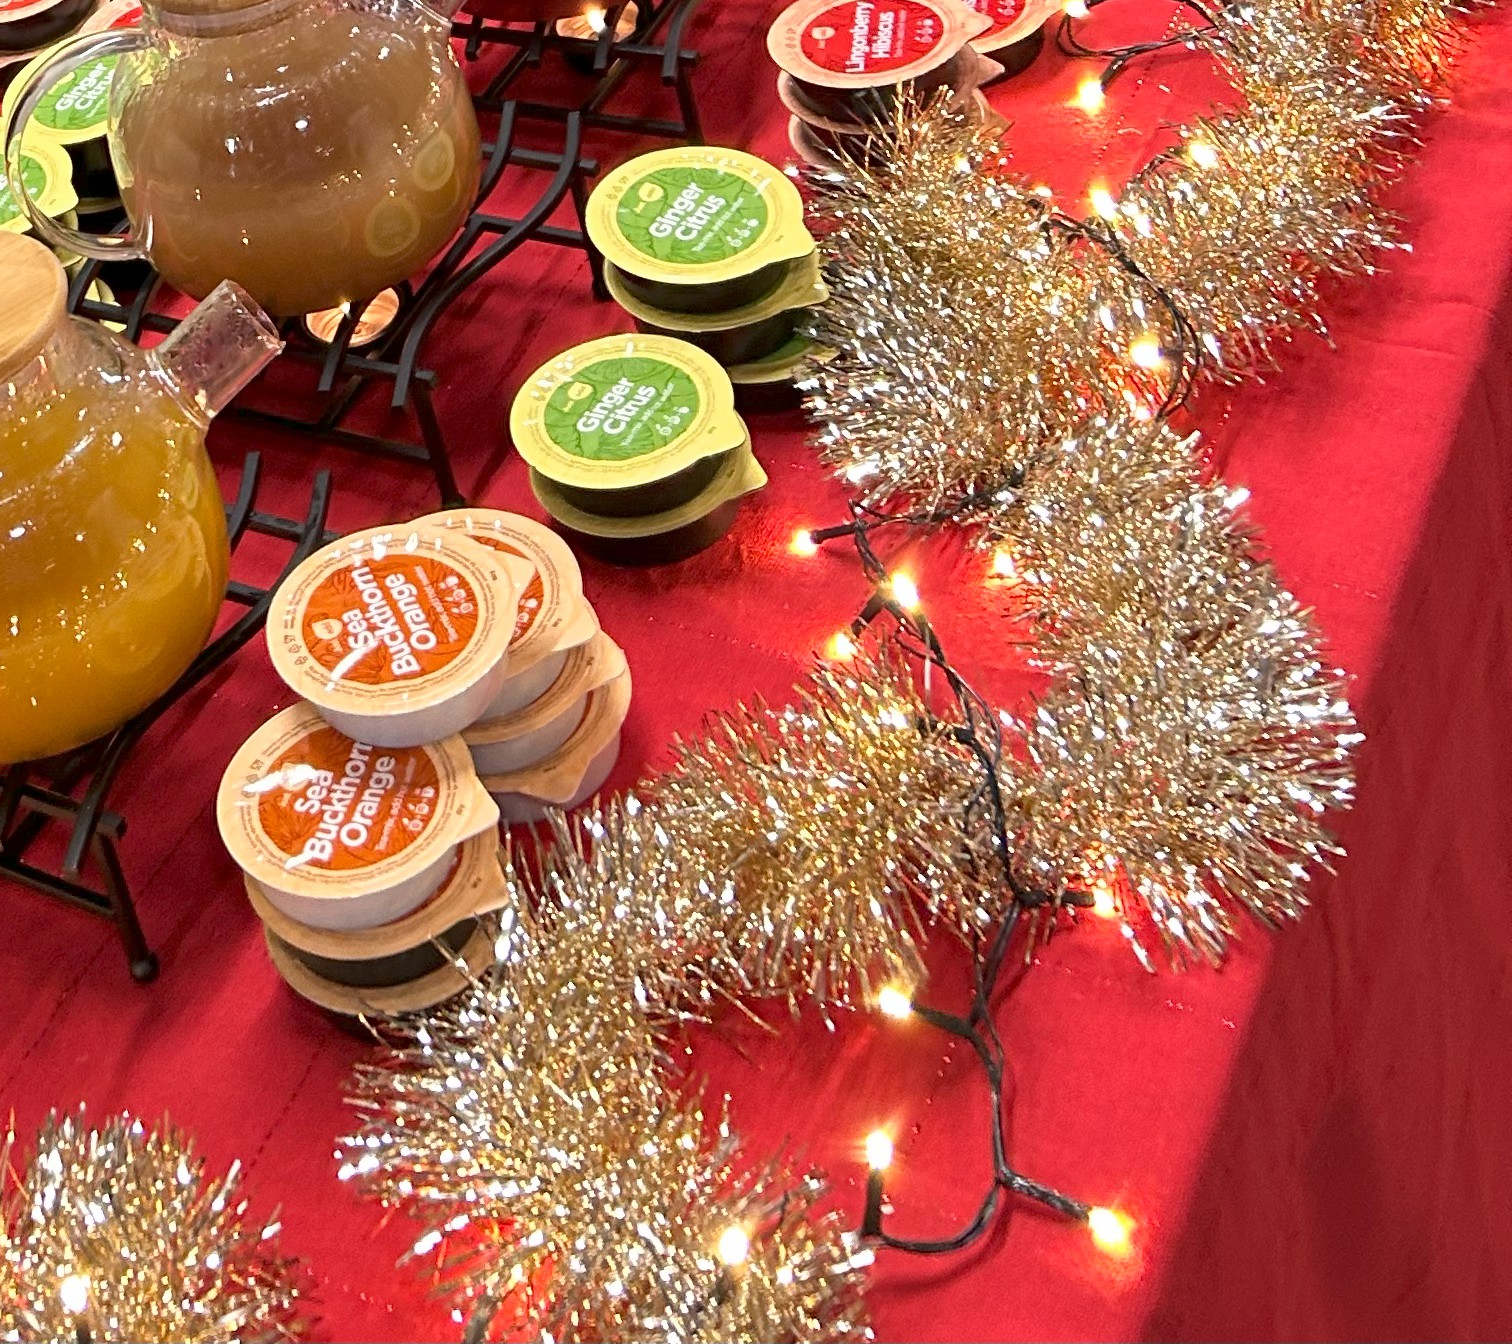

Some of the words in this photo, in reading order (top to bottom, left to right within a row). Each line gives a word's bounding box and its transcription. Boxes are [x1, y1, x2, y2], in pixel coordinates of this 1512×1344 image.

[845, 1, 875, 73] Lingonberry
[872, 11, 895, 58] Hibiscus
[55, 63, 107, 111] Ginger
[649, 182, 704, 238] Ginger
[675, 195, 726, 241] Citrus
[576, 378, 634, 432] Ginger
[603, 385, 656, 434] Citrus
[342, 608, 376, 650] Sea
[351, 566, 421, 676] Buckthorn
[385, 573, 437, 650] Orange
[293, 769, 334, 814] Sea
[340, 756, 396, 847] Orange
